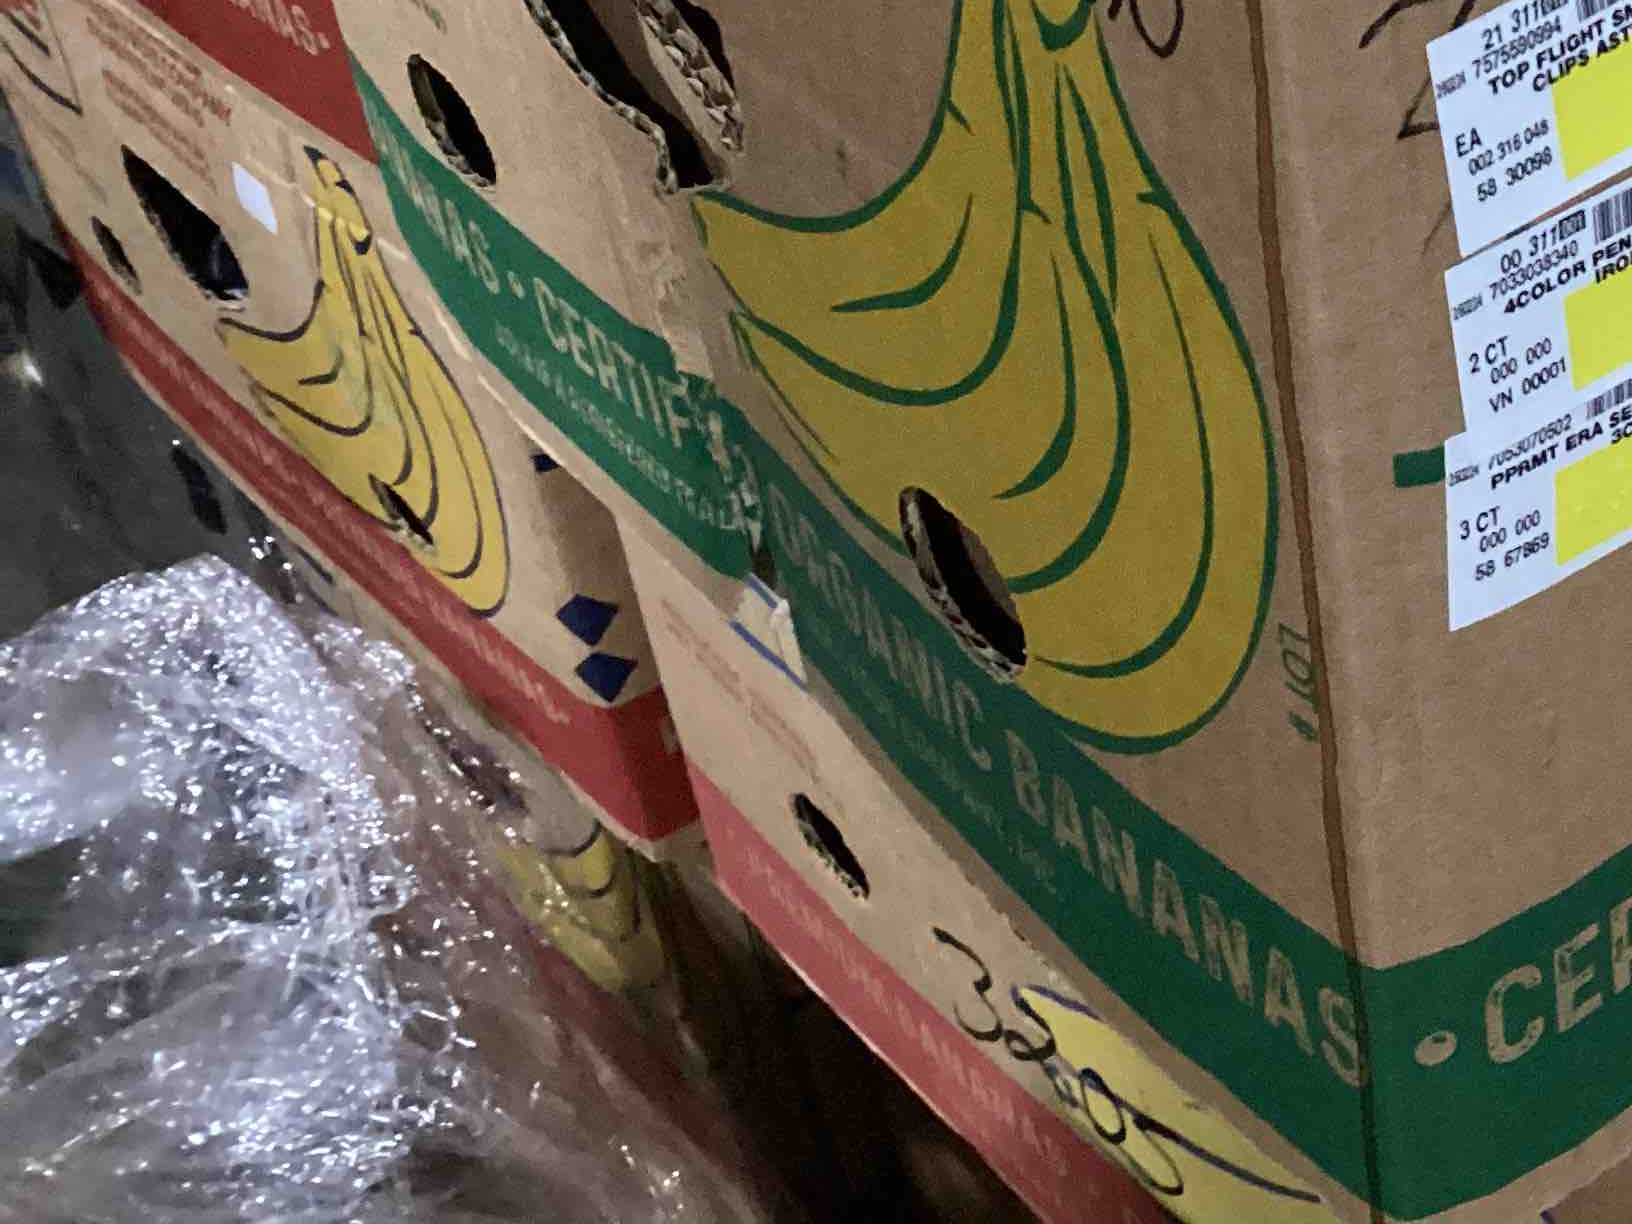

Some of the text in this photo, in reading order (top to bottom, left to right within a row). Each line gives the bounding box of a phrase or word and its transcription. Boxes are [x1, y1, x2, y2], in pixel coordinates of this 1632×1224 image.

[1482, 26, 1503, 51] 21
[1488, 68, 1532, 96] TOP
[1535, 22, 1605, 70] FLIGHT
[1532, 49, 1590, 93] CLIPS
[1455, 126, 1483, 158] EA
[1503, 259, 1587, 315] 4COLOR
[1591, 231, 1632, 267] PEN
[1468, 335, 1510, 375] 2 CT
[1487, 387, 1514, 414] VN
[1490, 441, 1561, 490] PPRMT
[1564, 421, 1604, 454] ERA
[1460, 505, 1501, 542] 3 CT
[767, 484, 993, 774] ORGANIC
[1006, 729, 1367, 1090] BANANAS
